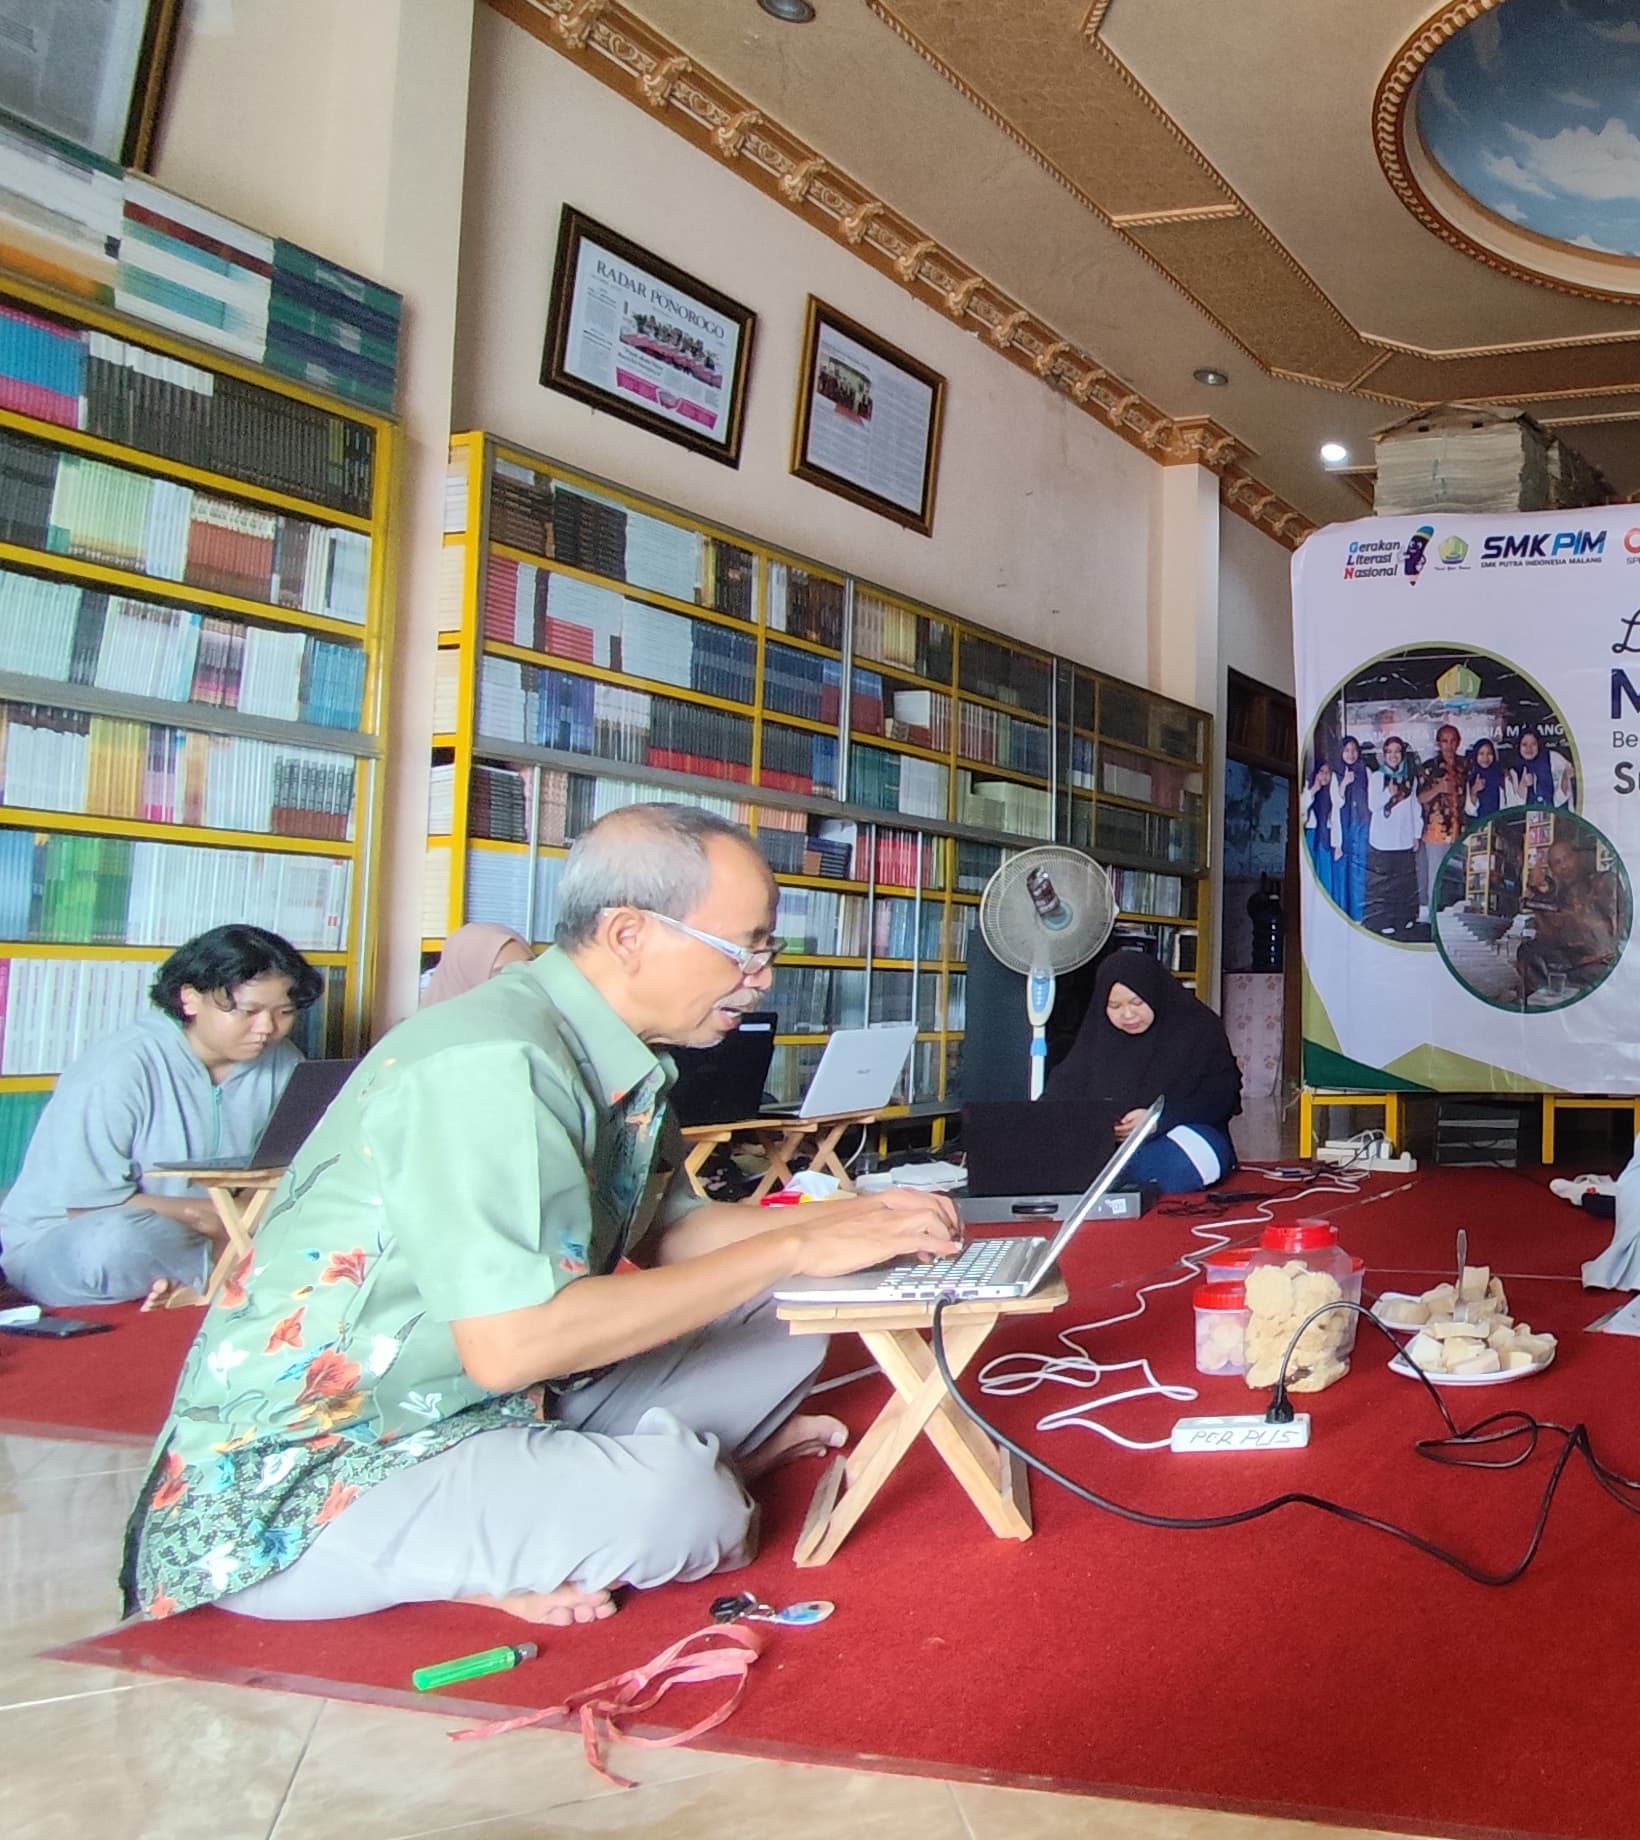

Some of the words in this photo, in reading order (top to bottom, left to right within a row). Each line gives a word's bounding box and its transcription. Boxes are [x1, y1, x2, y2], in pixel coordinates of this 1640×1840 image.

[597, 260, 647, 298] RADAR
[651, 289, 725, 339] PONOROGO
[1349, 539, 1401, 553] Gerakan
[1347, 552, 1393, 566] Literasi
[1480, 561, 1497, 569] SMK
[1499, 559, 1523, 568] PUTRA
[1525, 558, 1567, 567] INDONESIA
[1568, 556, 1602, 565] MALANG
[1344, 563, 1399, 580] Nasional
[1506, 723, 1564, 737] MANG
